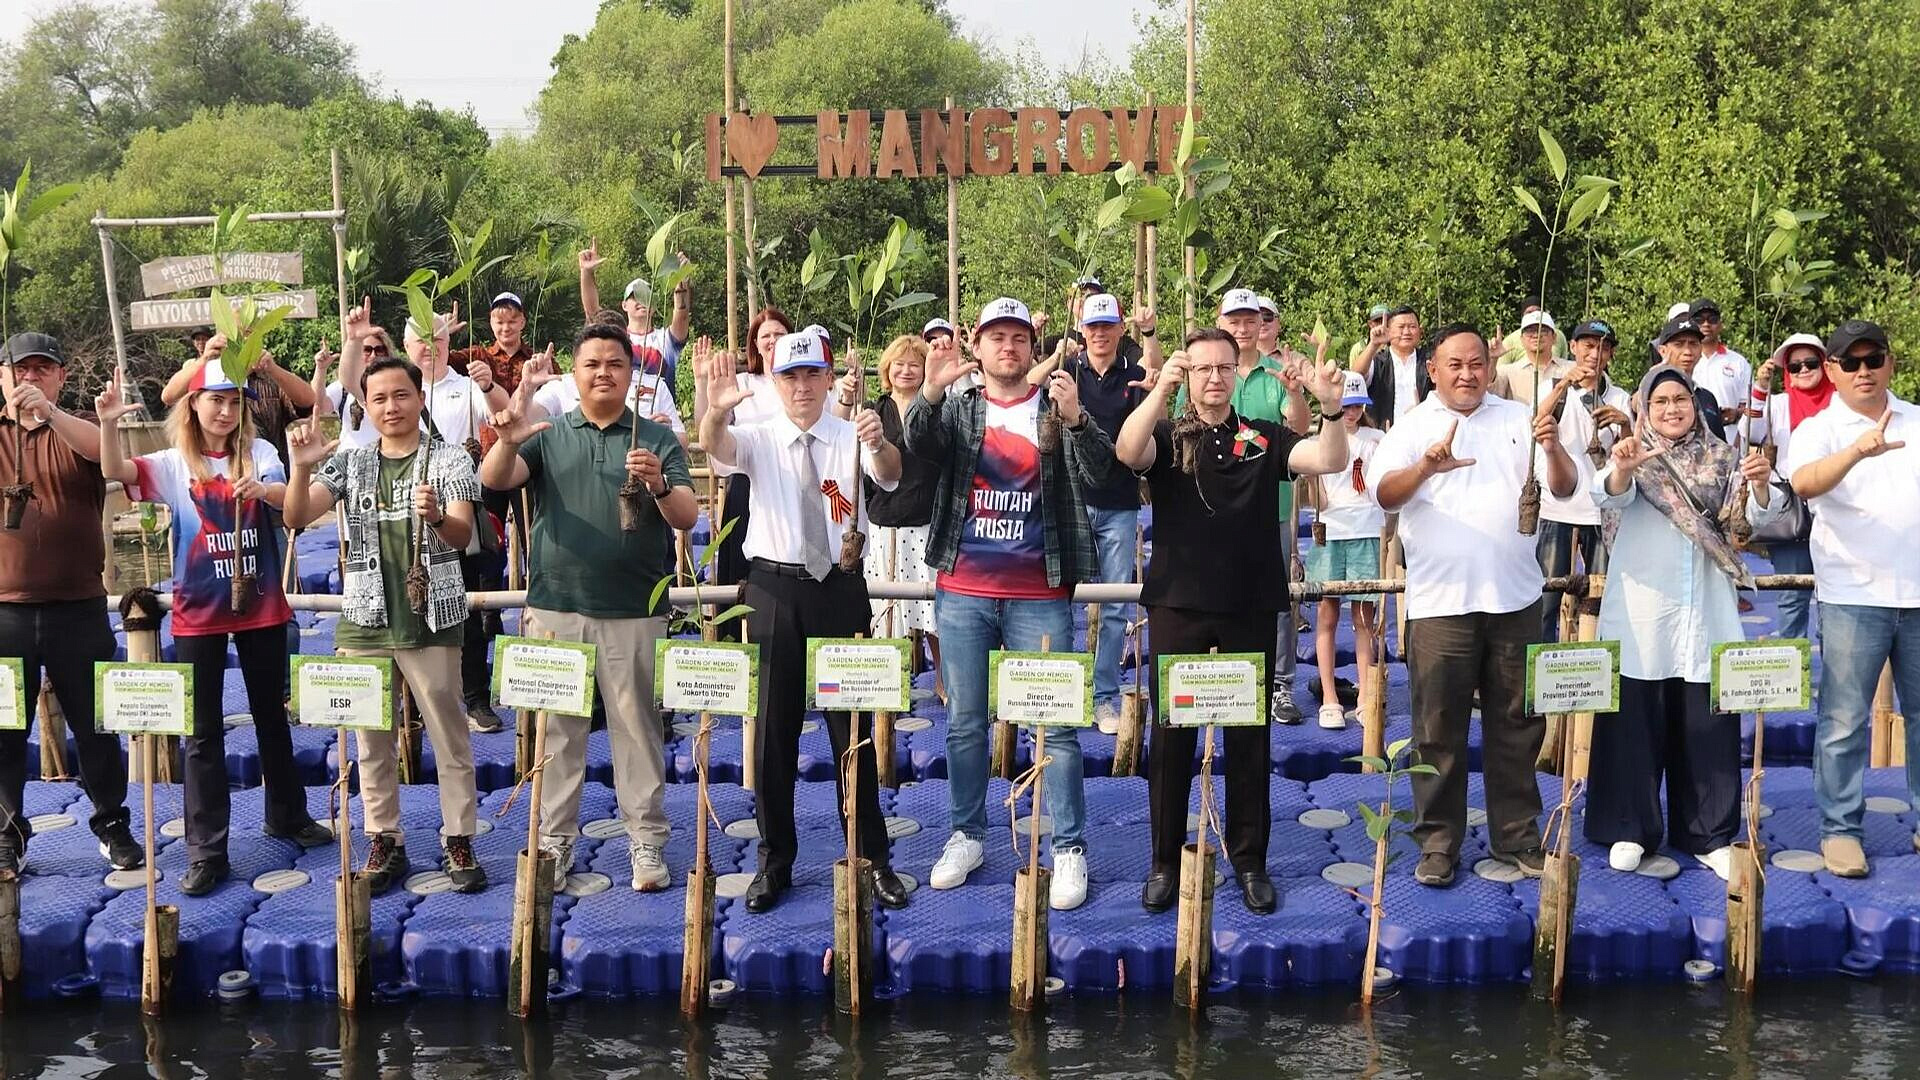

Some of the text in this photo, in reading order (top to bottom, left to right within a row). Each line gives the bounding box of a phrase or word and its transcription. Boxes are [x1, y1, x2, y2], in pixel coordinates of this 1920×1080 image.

[705, 106, 1201, 182] I MANGROVE
[174, 265, 284, 289] PEDULI MANGROVE
[142, 302, 193, 325] NYOK
[974, 489, 1033, 512] RUMAH
[975, 517, 1025, 541] RUSIA
[213, 555, 257, 579] RUIA
[509, 678, 578, 691] National Chairperson
[511, 685, 536, 693] Generasi
[683, 689, 729, 698] Jakarta Utara
[694, 682, 736, 691] Administrasi
[1555, 681, 1591, 689] Pemerintah
[330, 698, 351, 708] IESR
